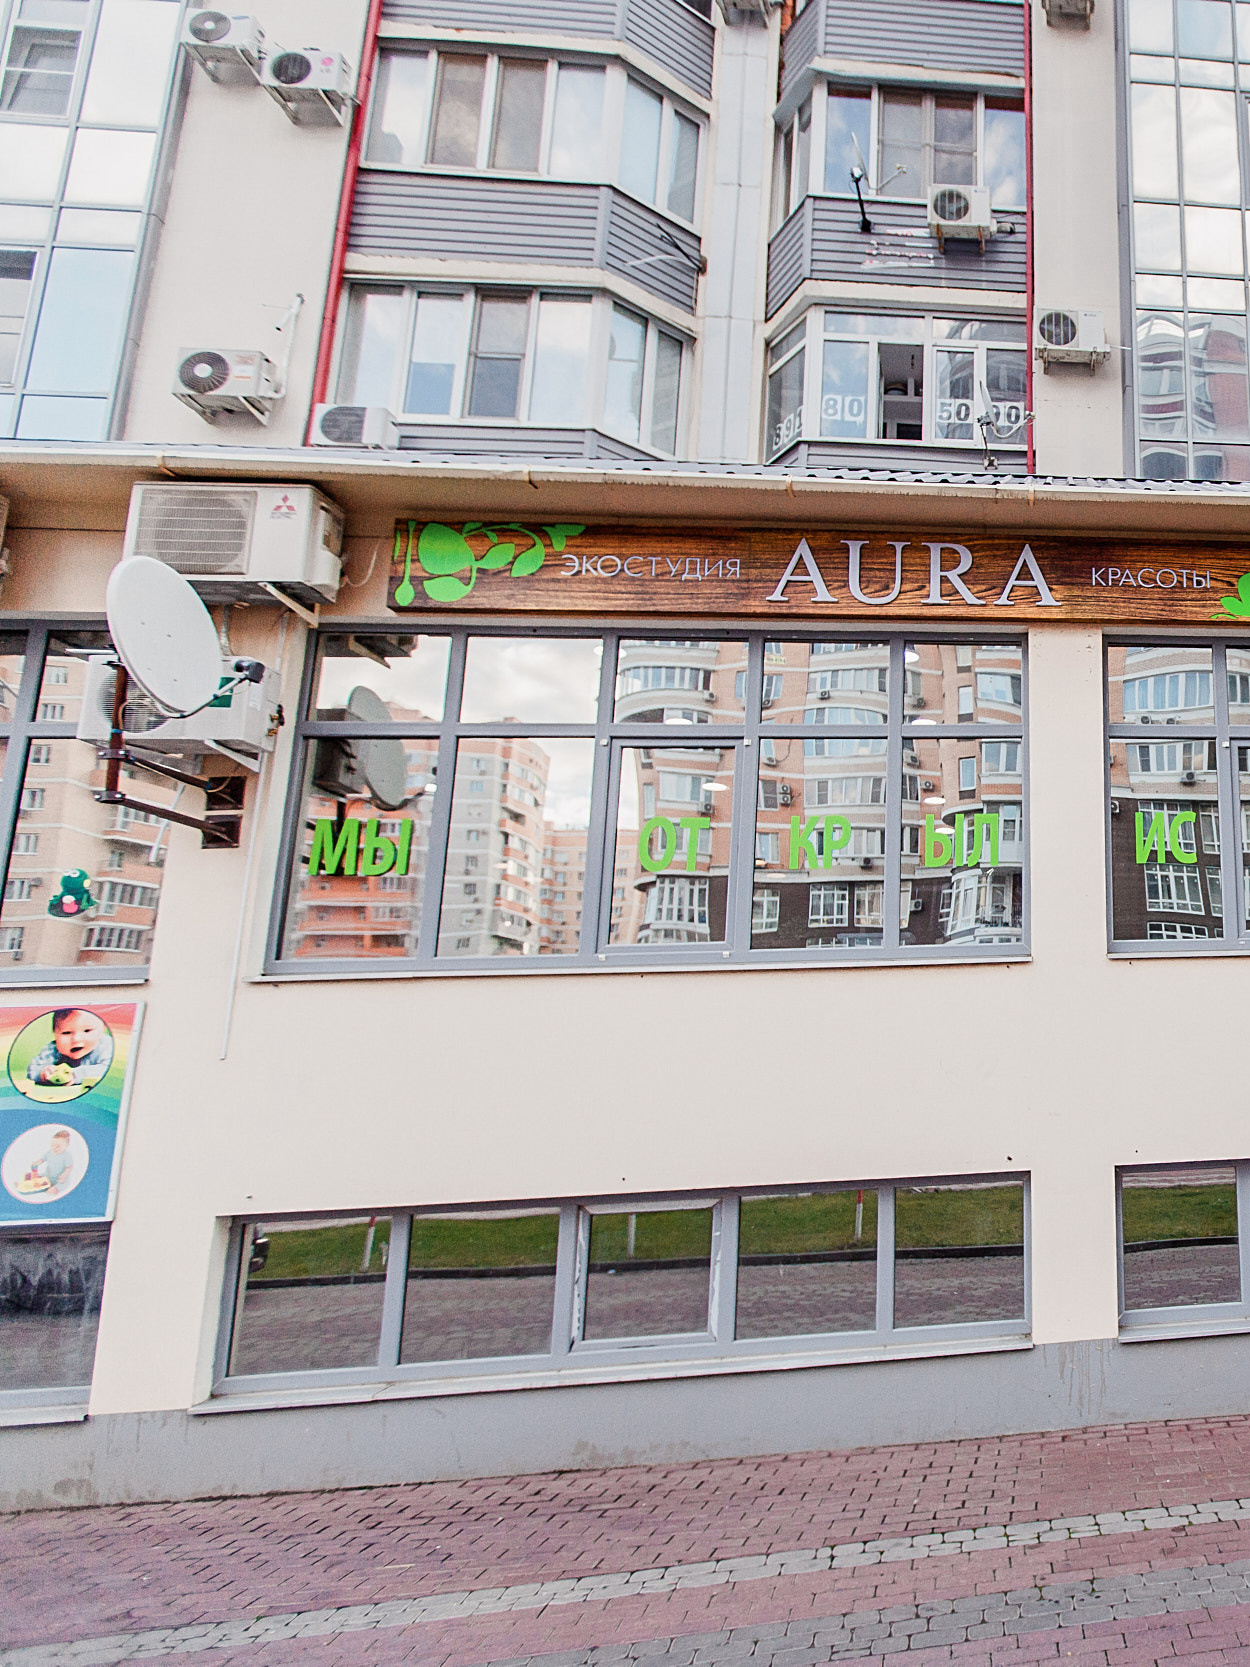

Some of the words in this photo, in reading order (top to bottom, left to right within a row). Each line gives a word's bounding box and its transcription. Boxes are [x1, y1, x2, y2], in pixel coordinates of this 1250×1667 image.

[823, 397, 863, 418] 80
[938, 402, 971, 422] 50
[559, 553, 741, 582] ЭКОСТУДИЯ
[764, 537, 1064, 607] AURA
[1091, 566, 1212, 589] КРАСОТЫ
[307, 818, 413, 876] МЫ
